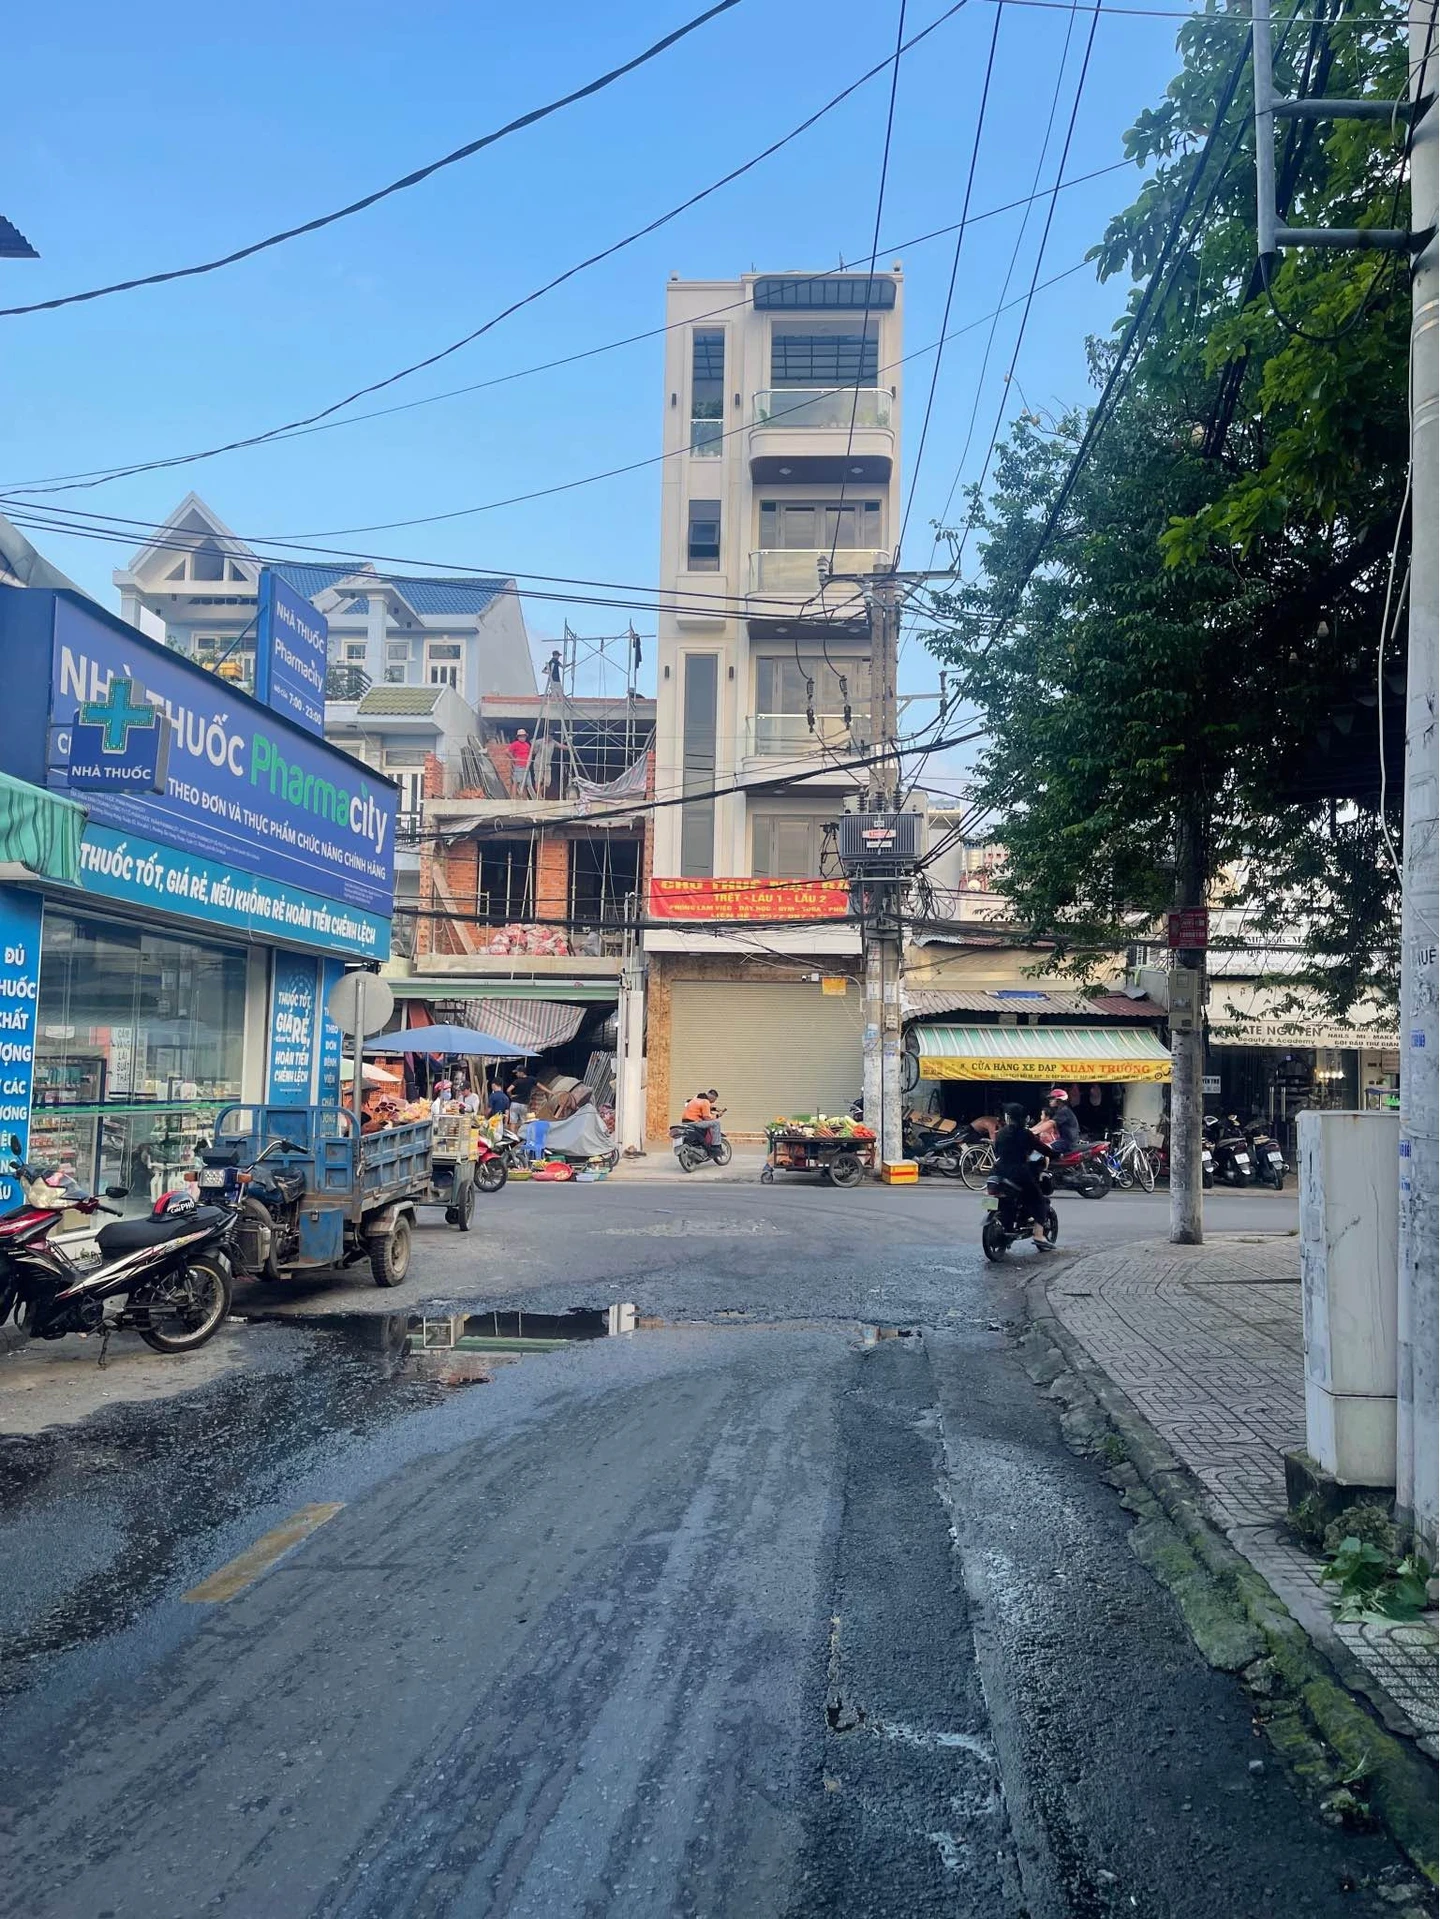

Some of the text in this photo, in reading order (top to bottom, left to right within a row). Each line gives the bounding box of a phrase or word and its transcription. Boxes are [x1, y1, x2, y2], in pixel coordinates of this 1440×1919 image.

[277, 601, 325, 655] NHÀ THUỐC
[275, 637, 324, 693] Pharmacity
[71, 764, 152, 780] NHÀ THUỐC
[250, 732, 388, 855] Pharmacity
[168, 777, 199, 806] THEO
[202, 792, 227, 817] ĐƠN
[229, 801, 242, 823] VÀ
[243, 809, 269, 836] THỰC
[270, 819, 296, 845] PHẨM
[297, 833, 320, 854] CHỨC
[321, 843, 344, 863] NĂNG
[344, 851, 367, 872] CHÍNH
[80, 841, 134, 881] THUỐC
[136, 852, 165, 893] TỐT,
[166, 866, 189, 897] GIÁ
[189, 871, 209, 906] RẺ,
[210, 874, 235, 909] NẾU
[234, 886, 271, 918] KHÔNG
[272, 894, 286, 921] RẺ
[286, 901, 311, 929] HOÀN
[312, 904, 331, 934] TIỀN
[331, 913, 357, 939] CHÊNH
[357, 920, 377, 948] LỆCH
[661, 880, 703, 890] CHO
[777, 893, 783, 903] 1
[818, 894, 828, 903] 2
[4, 943, 25, 966] ĐỦ
[0, 975, 36, 999] HUỐC
[1238, 1025, 1262, 1035] ATE
[1238, 1037, 1266, 1045] Beauty
[1277, 1037, 1316, 1046] Academy
[971, 1060, 1151, 1074] CỬA HÀNG XE ĐẠP XUÂN TRƯỜNG
[3, 1077, 26, 1096] CÁC
